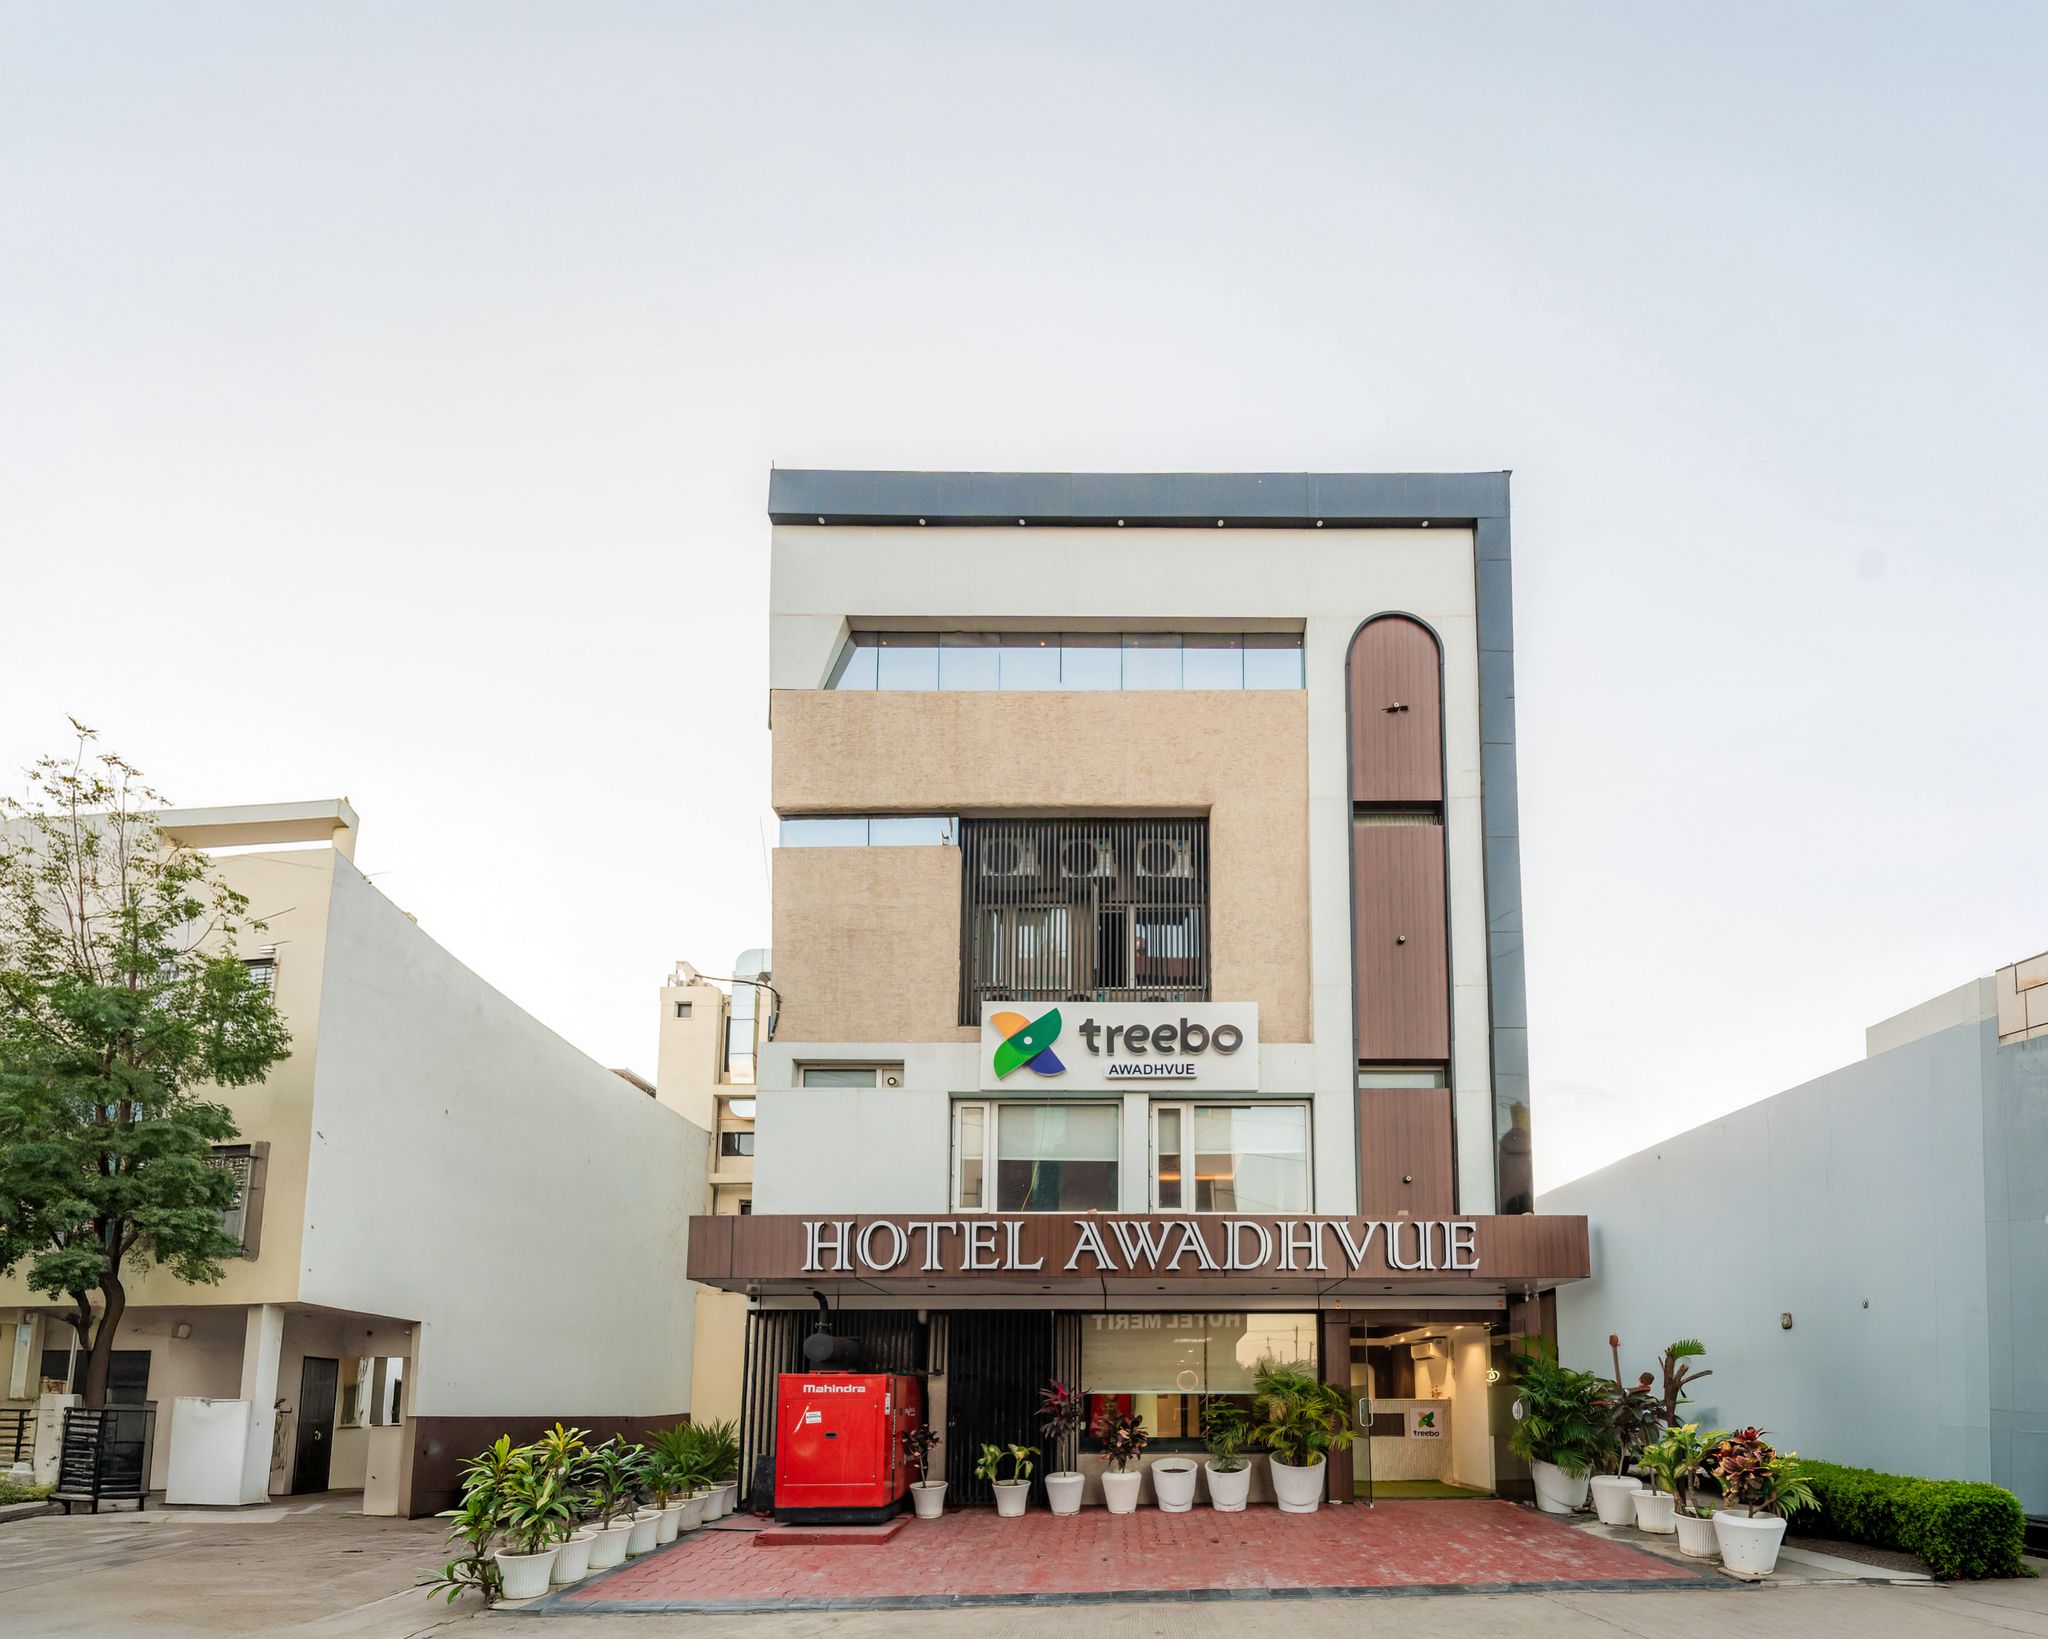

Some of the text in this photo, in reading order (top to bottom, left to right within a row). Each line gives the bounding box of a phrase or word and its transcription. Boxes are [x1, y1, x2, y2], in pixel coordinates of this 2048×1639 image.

[1079, 1017, 1243, 1056] treebo
[1108, 1063, 1196, 1076] AWADHVUE
[801, 1220, 1480, 1271] HOTEL AWADHVUE
[803, 1384, 866, 1393] Mahindra
